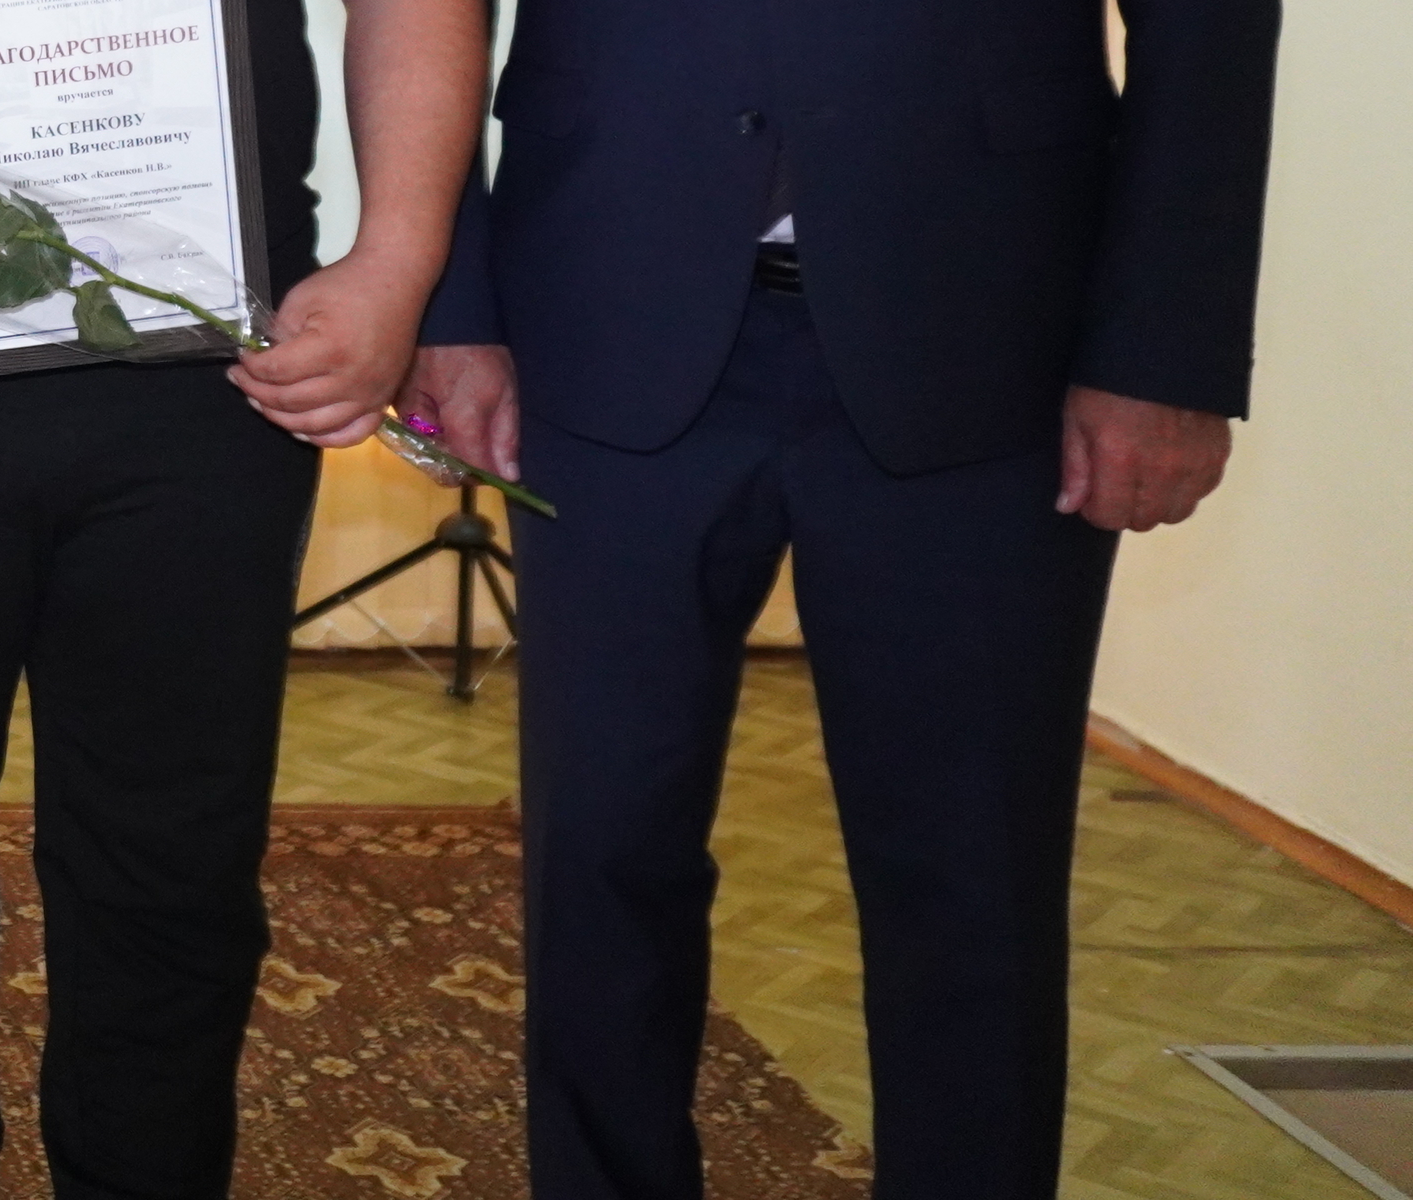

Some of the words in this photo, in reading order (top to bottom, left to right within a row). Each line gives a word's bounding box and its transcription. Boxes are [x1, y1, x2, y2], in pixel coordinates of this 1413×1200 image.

[34, 59, 133, 88] ПИСЬМО
[57, 88, 114, 103] вручается
[30, 112, 146, 140] КАСЕНКОВУ
[69, 130, 192, 155] Вячеславовичу
[14, 179, 30, 189] ИП
[63, 172, 88, 183] КФХ
[90, 167, 143, 179] «Касенков
[129, 186, 180, 197] спонсорскую
[181, 181, 213, 191] помощь
[113, 195, 182, 209] Екатериновского
